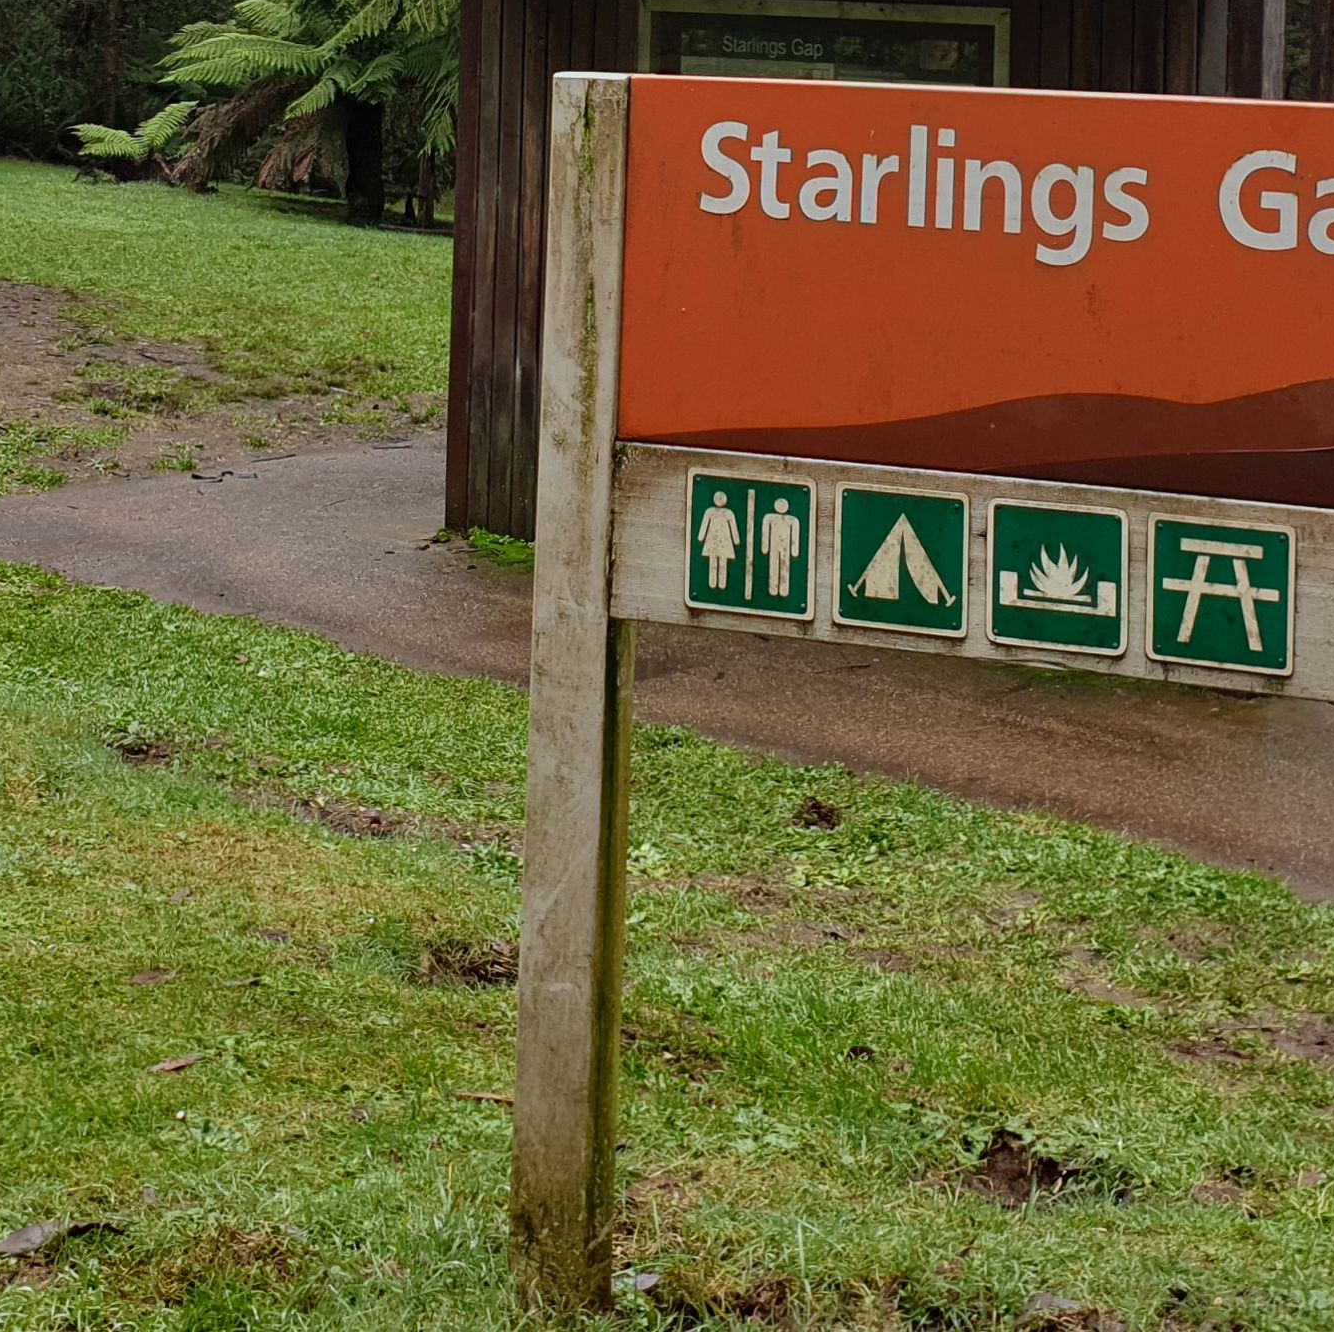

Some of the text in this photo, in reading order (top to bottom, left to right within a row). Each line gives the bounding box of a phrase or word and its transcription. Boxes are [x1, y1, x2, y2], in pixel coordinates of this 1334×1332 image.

[722, 34, 824, 59] Starlings Gap
[699, 120, 1151, 267] Starlings
